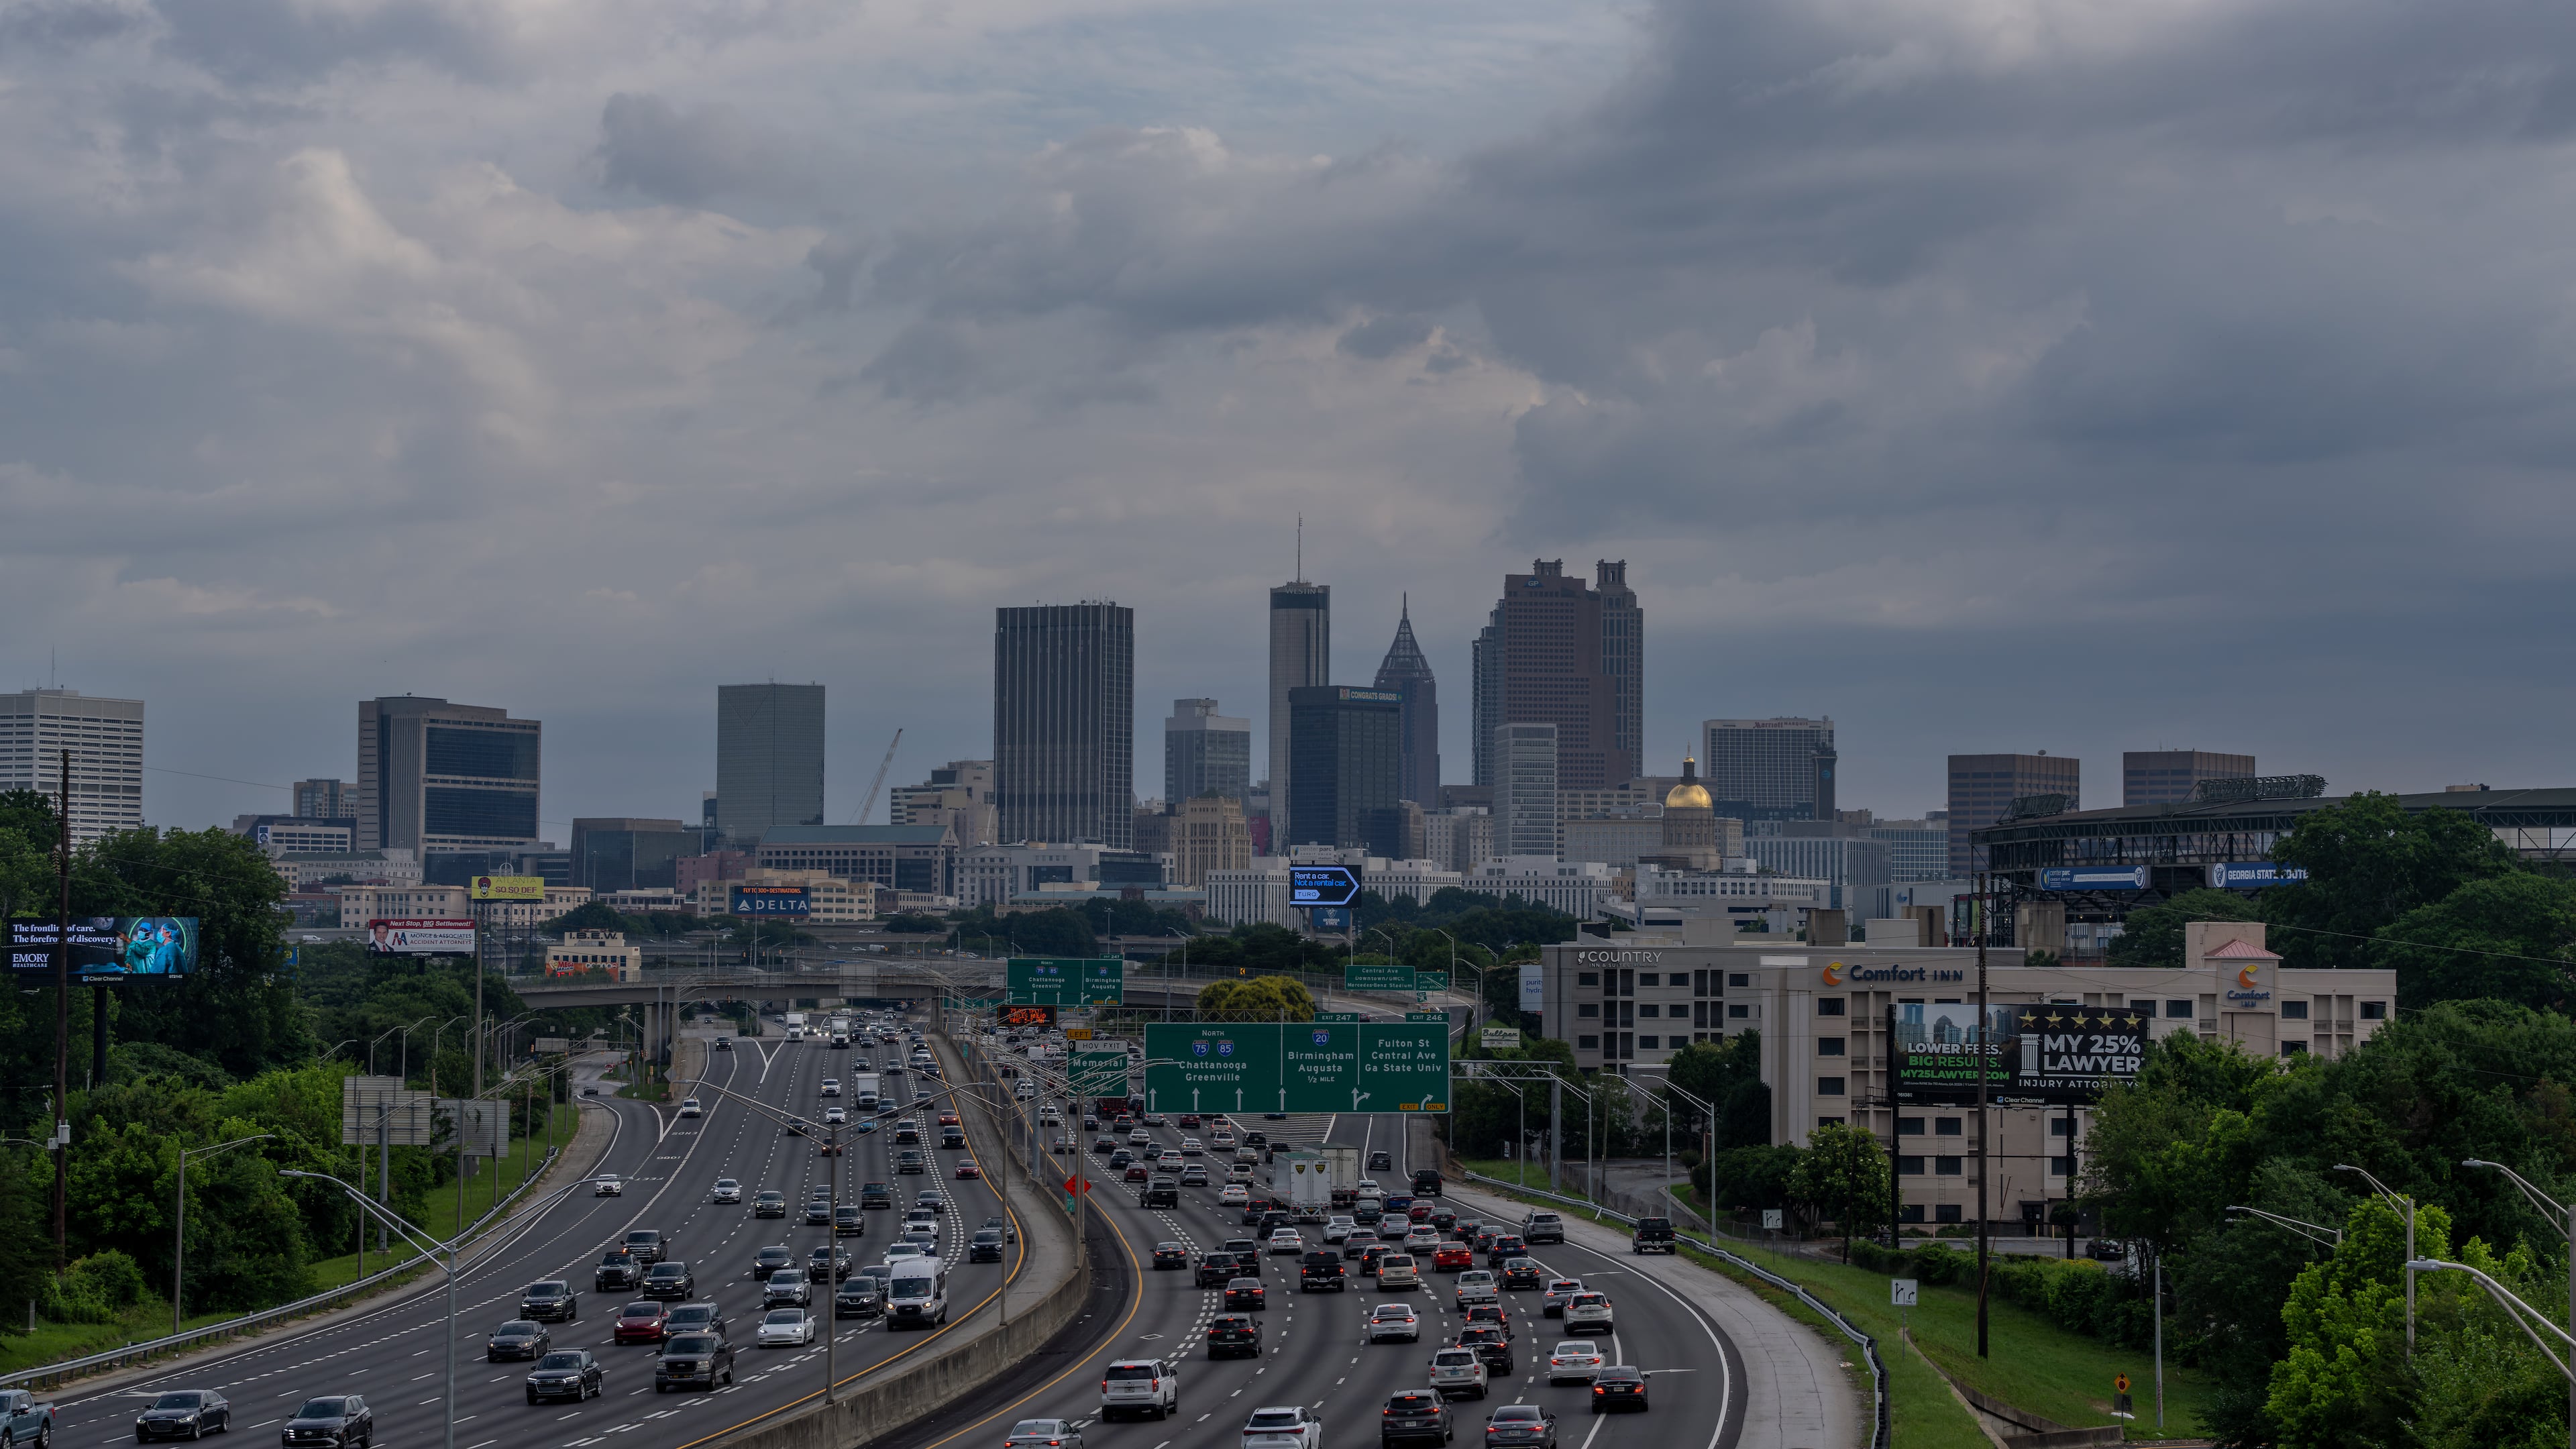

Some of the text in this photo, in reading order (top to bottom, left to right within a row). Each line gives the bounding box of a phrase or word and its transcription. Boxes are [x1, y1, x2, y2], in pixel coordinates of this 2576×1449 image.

[1350, 691, 1397, 701] CONGRATS GRADS!
[2228, 870, 2256, 879] GEORGIA
[756, 900, 808, 910] DELTA
[13, 924, 30, 932] The
[67, 924, 76, 932] of
[13, 934, 30, 943] The
[76, 934, 115, 945] discovery.
[12, 953, 50, 963] EMORY
[1850, 964, 1963, 981] Comfort INN
[2227, 989, 2270, 999] Comfort
[1316, 1034, 1327, 1042] 20
[1483, 1029, 1517, 1038] Bullpen
[1378, 1039, 1430, 1047] Fulton St
[2044, 1034, 2141, 1054] MY 25%
[1195, 1044, 1232, 1053] 75 85
[1907, 1042, 1961, 1055] LOWER
[1287, 1051, 1354, 1062] Birmingham
[1371, 1051, 1436, 1059] Central Ave
[1179, 1061, 1246, 1071] Chattanooga
[1909, 1056, 1933, 1067] BIG
[1298, 1064, 1342, 1074] Augusta
[1364, 1064, 1442, 1072] Ga State Univ
[1185, 1073, 1240, 1081] Greenville
[2019, 1079, 2063, 1088] INJURY
